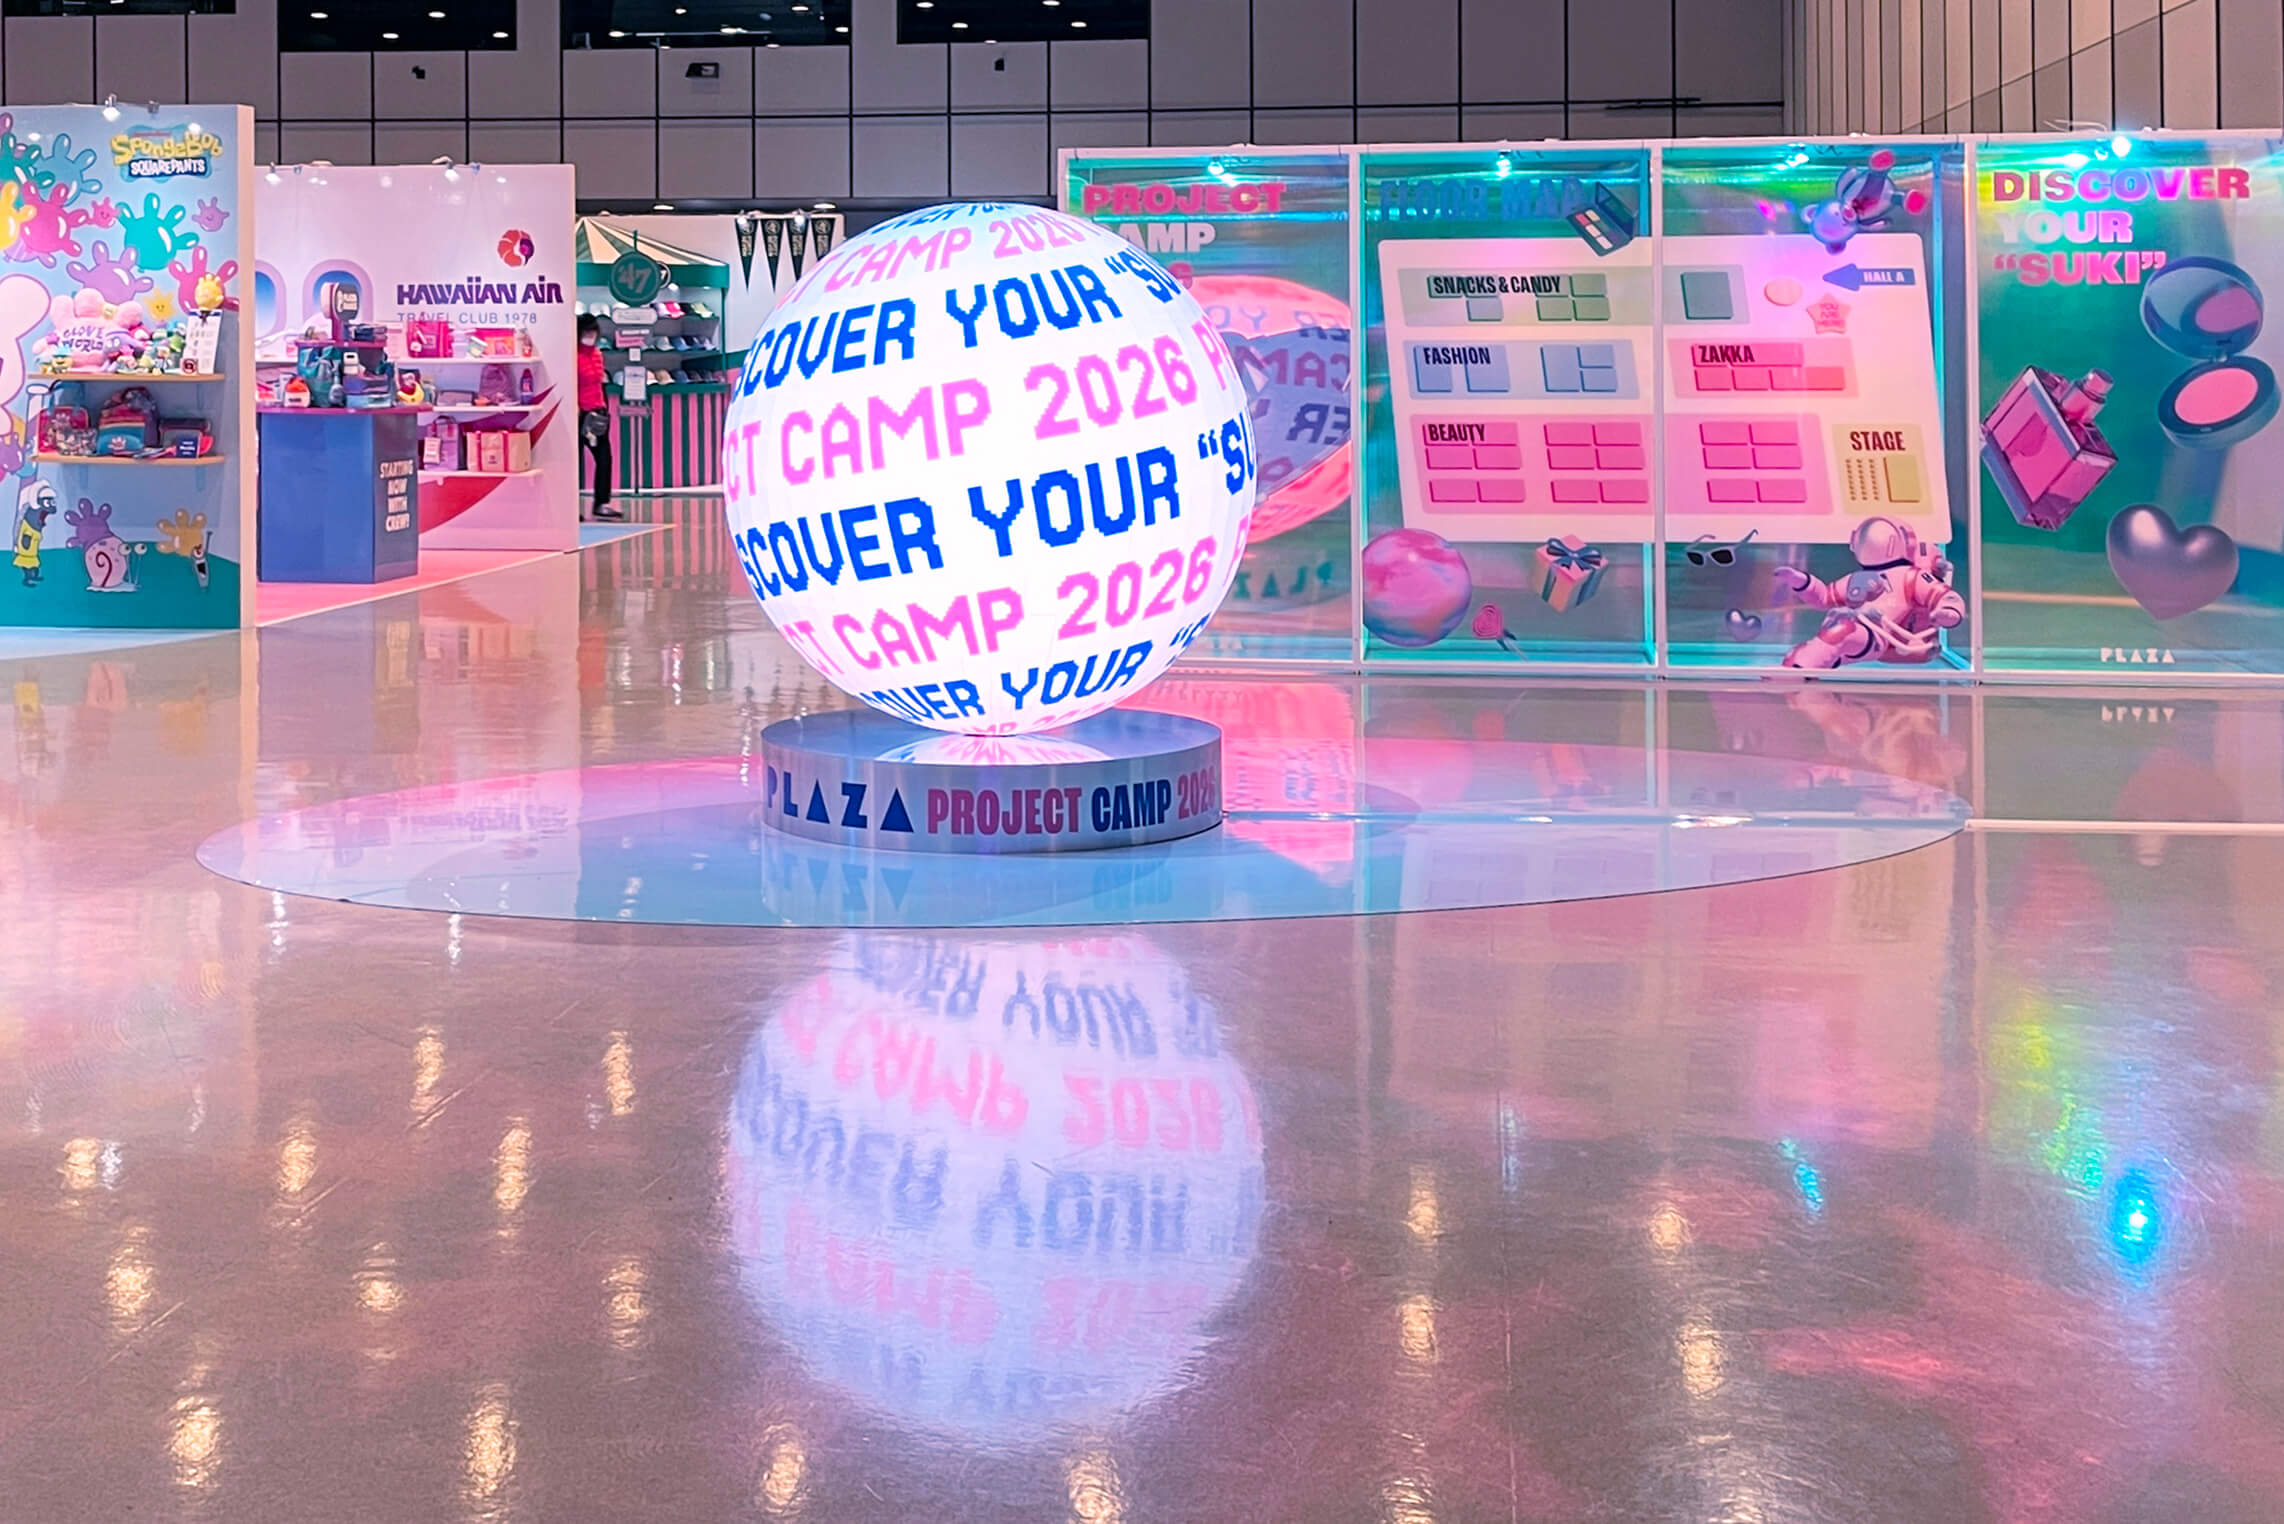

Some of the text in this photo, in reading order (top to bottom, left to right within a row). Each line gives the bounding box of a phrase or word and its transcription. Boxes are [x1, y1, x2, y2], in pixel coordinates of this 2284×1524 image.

[1083, 182, 1286, 214] PROJECT
[1380, 176, 1587, 221] FLOOR MAP
[1993, 167, 2251, 202] DISCOVER
[1103, 222, 1217, 253] AMP
[1994, 210, 2134, 244] YOUR
[824, 226, 972, 293] CAMP
[988, 213, 1087, 259] 2026
[1433, 275, 1561, 295] SNACKS & CANDY
[1863, 271, 1905, 283] HALL A
[458, 313, 499, 324] CLUB
[505, 313, 537, 324] 1978
[945, 262, 1122, 348] YOUR
[1423, 346, 1491, 365] FASHION
[1699, 344, 1756, 363] ZAKKA
[781, 378, 991, 486] CAMP
[1024, 336, 1197, 440] 2026
[1428, 424, 1485, 442] BEAUTY
[1850, 431, 1907, 451] STAGE
[967, 446, 1181, 557] YOUR
[832, 587, 1024, 670] CAMP
[1057, 535, 1217, 641] 2026
[2100, 647, 2175, 664] PLAZA
[1001, 640, 1154, 710] YOUR
[767, 764, 914, 834] PLAZA
[927, 786, 1082, 836] PROJECT
[1092, 779, 1173, 833] CAMP
